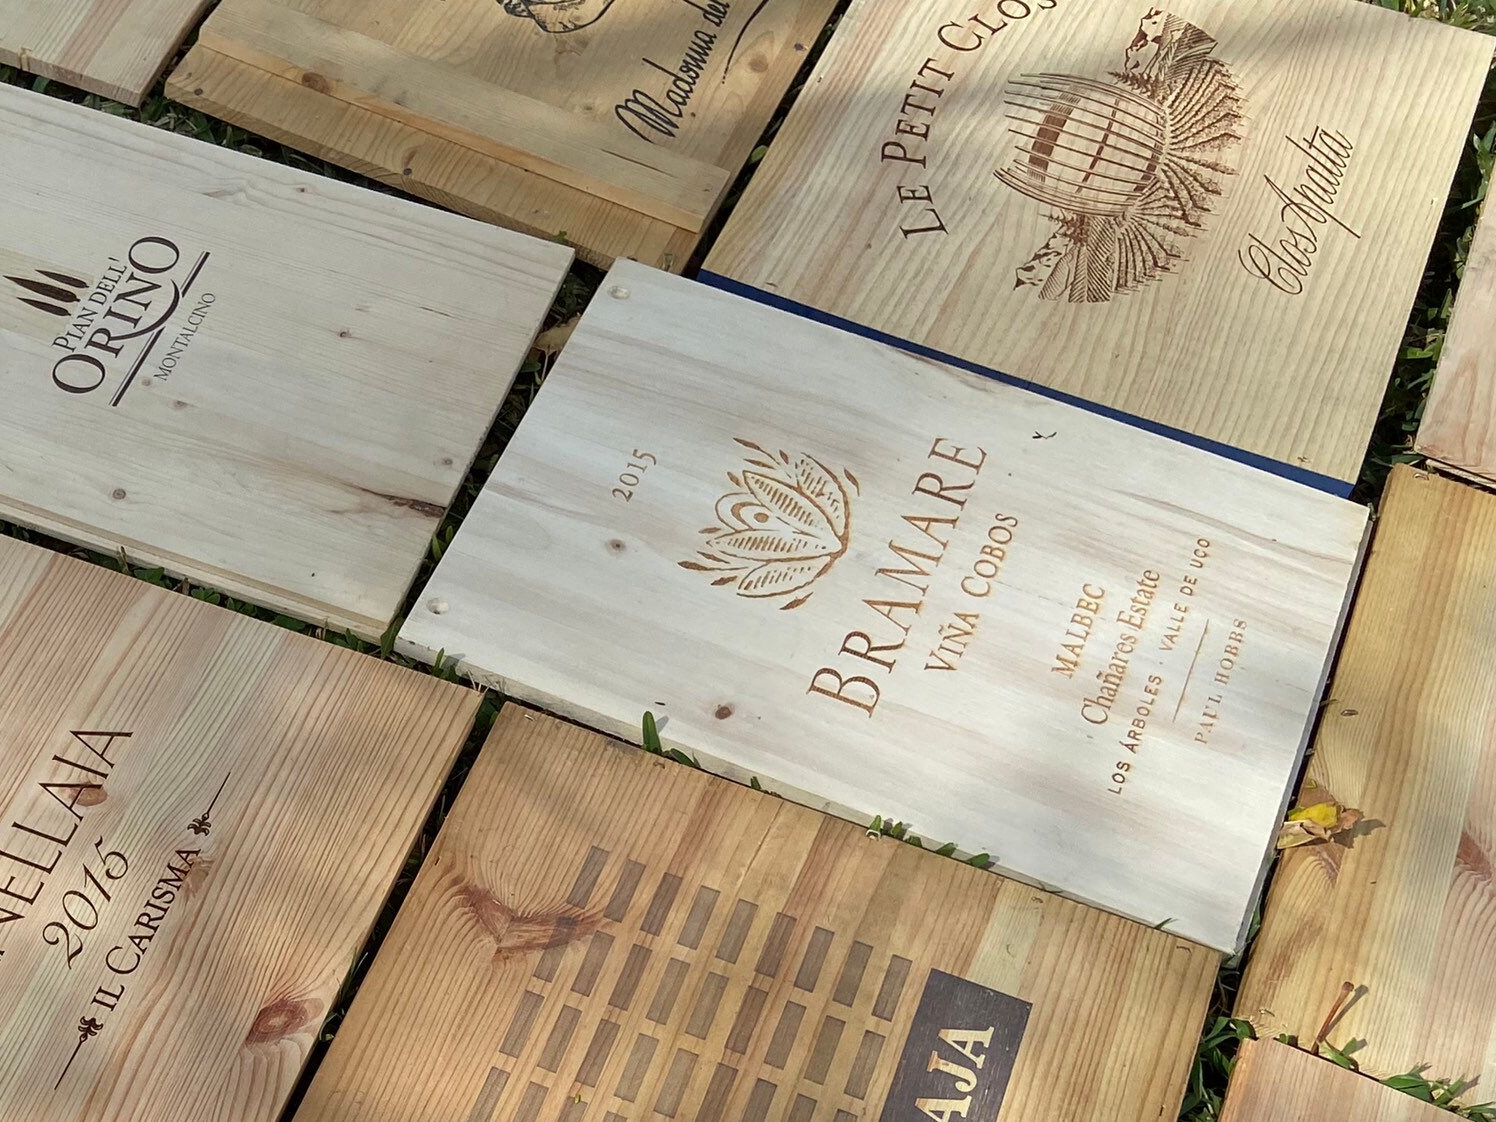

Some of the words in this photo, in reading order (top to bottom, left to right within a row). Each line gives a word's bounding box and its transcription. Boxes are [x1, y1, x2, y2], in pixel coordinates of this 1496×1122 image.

[615, 30, 717, 144] Madonna
[881, 57, 955, 170] PETIT
[897, 185, 949, 240] LE
[52, 236, 180, 394] ORINO
[52, 307, 99, 353] PIAN
[153, 292, 216, 382] MONTALCINO
[611, 448, 658, 503] 2015
[805, 436, 988, 719] BRAMARE
[923, 610, 982, 672] VIÑA
[960, 512, 1019, 599] COBOS
[1051, 583, 1105, 680] MALBEC
[1080, 633, 1138, 725] Chañares
[1116, 569, 1161, 631] Estate
[1107, 761, 1131, 795] LOS
[1159, 603, 1188, 651] VALLE
[1179, 575, 1198, 596] DE
[1194, 694, 1223, 745] PAUL
[1214, 618, 1248, 685] HOBBS
[42, 836, 130, 970] 2015
[104, 845, 202, 976] CARISMA
[90, 983, 126, 1012] IL
